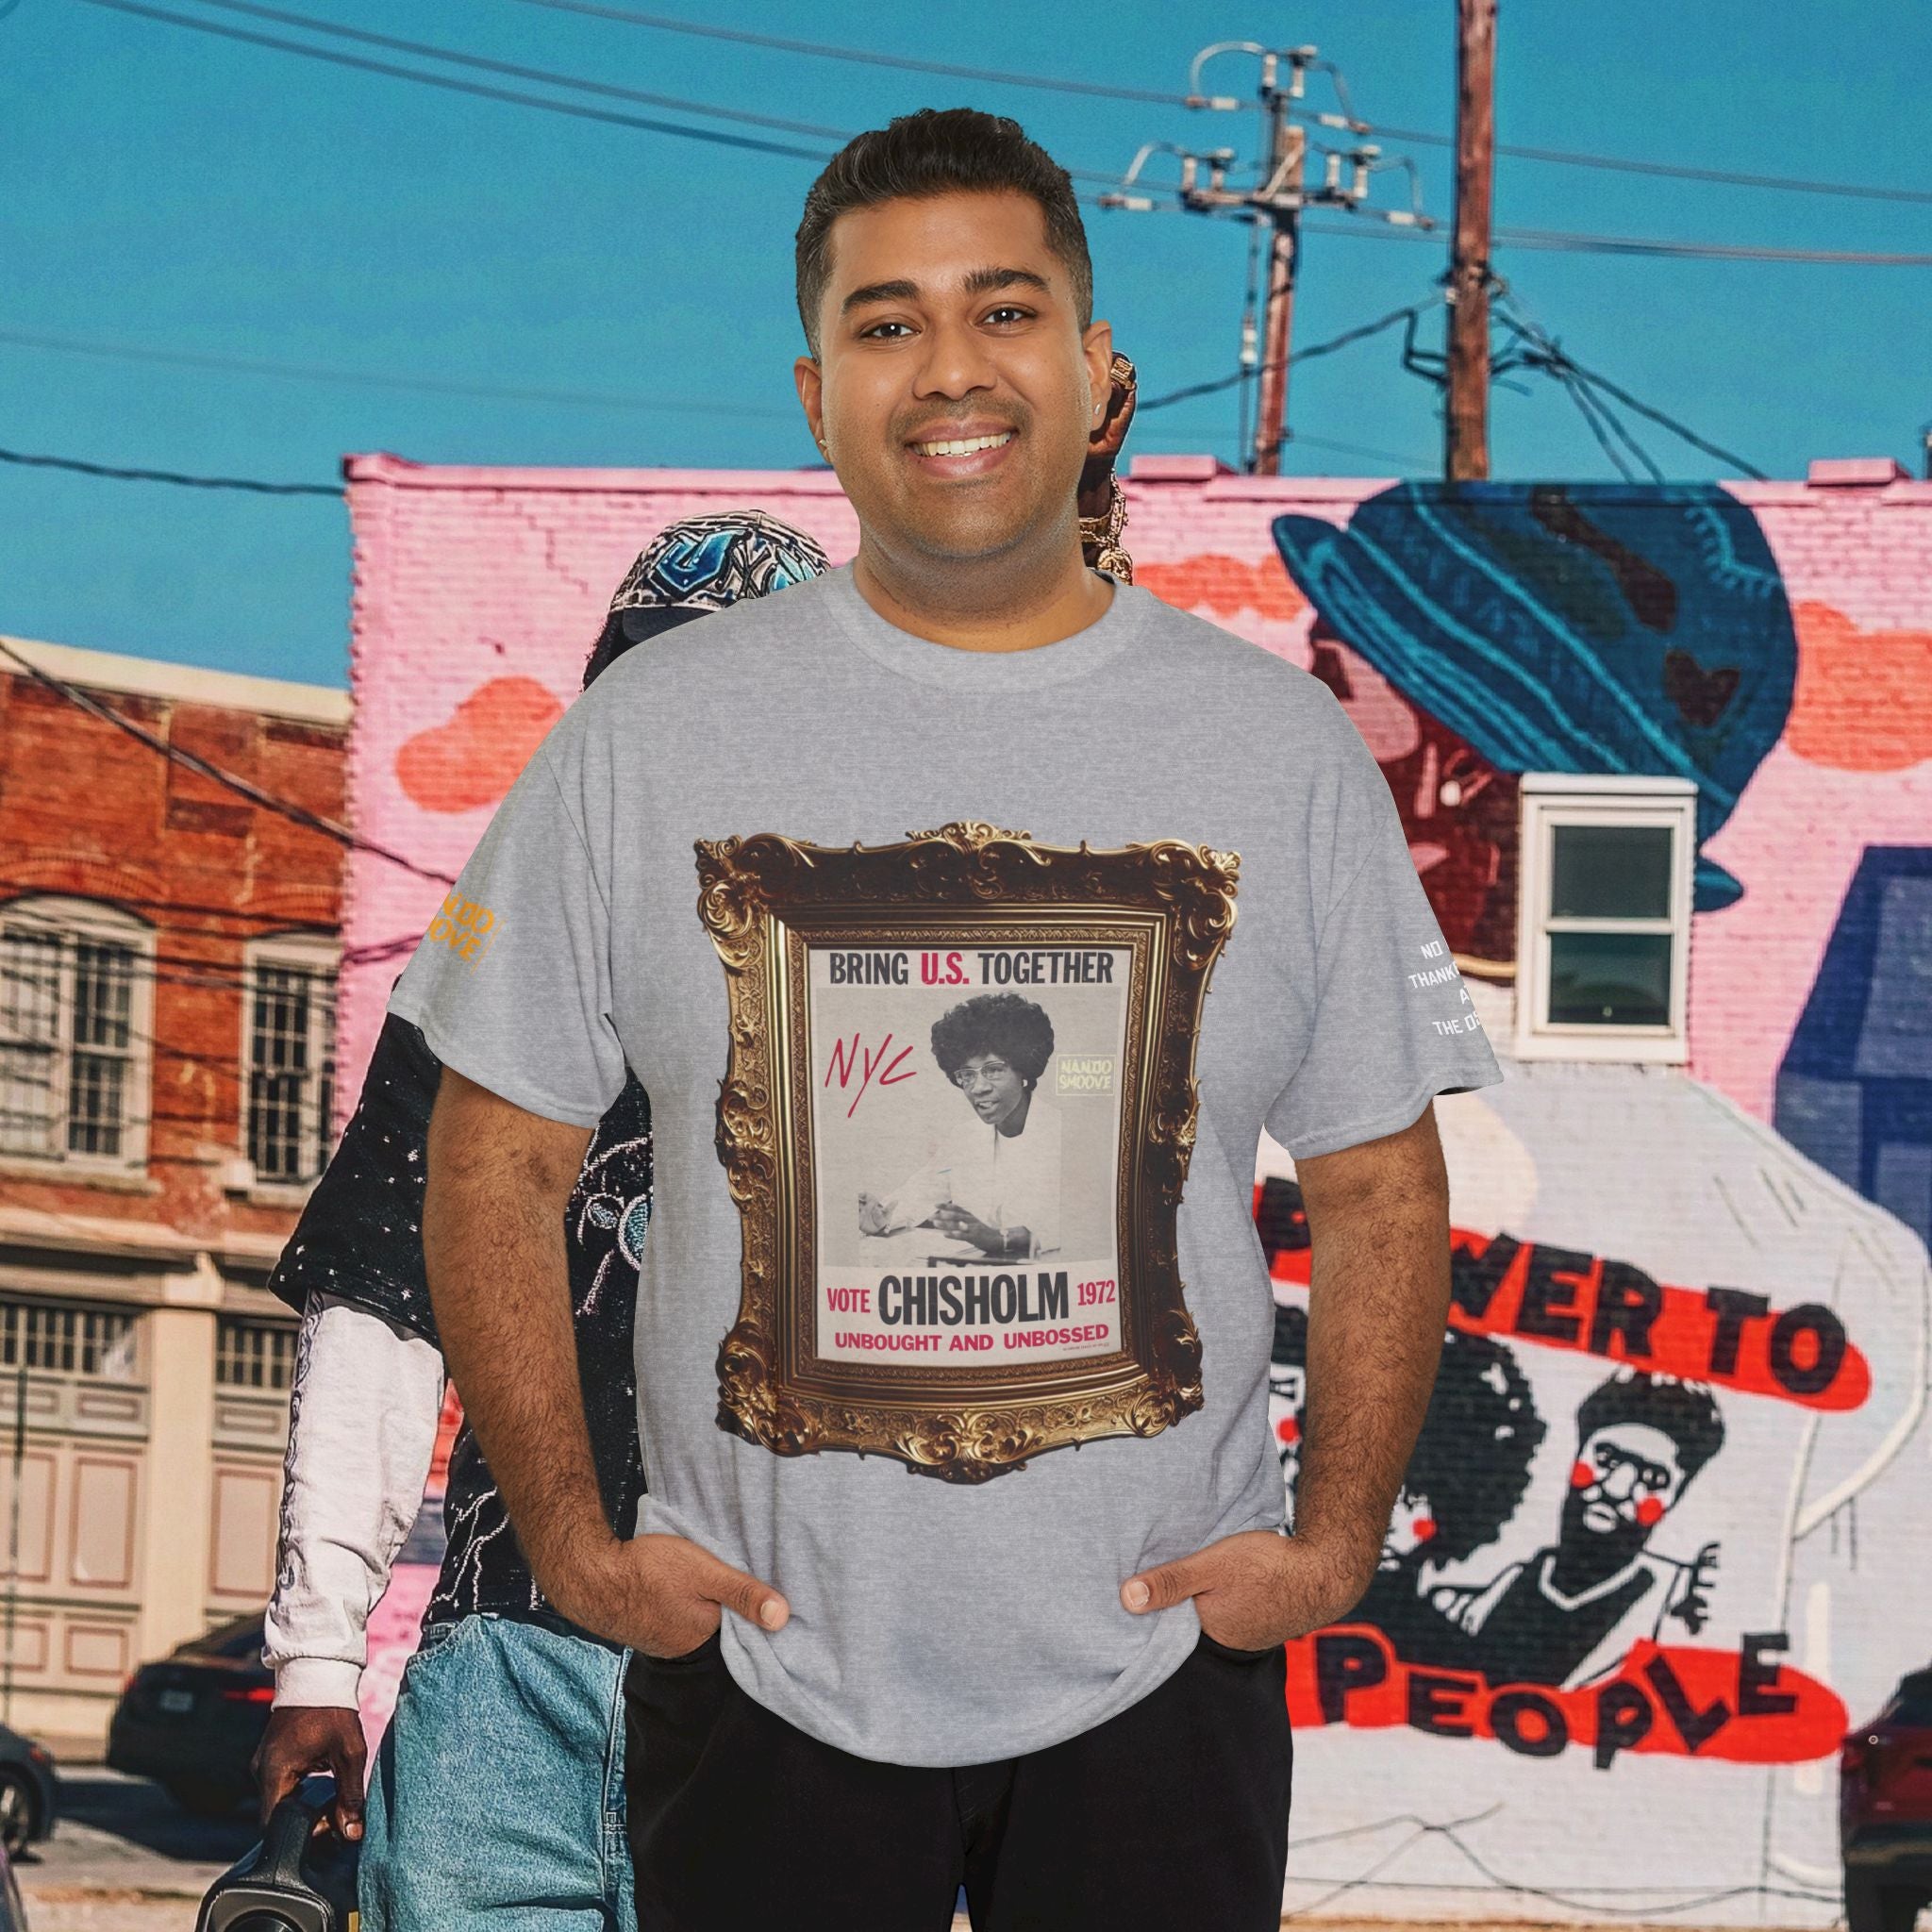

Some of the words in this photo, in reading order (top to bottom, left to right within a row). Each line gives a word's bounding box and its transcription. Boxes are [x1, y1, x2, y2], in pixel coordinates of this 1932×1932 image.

[829, 952, 908, 985] BRING
[921, 952, 970, 985] U.S.
[977, 951, 1114, 984] TOGETHER
[1432, 1020, 1464, 1036] THE
[824, 1032, 917, 1118] NYC
[826, 1287, 871, 1313] VOTE
[877, 1271, 1069, 1326] CHISHOLM
[1076, 1279, 1115, 1307] 1972
[1258, 1175, 1663, 1358] PWER
[1706, 1286, 1848, 1394] TO
[834, 1332, 942, 1352] UNBOUGHT
[948, 1334, 993, 1352] AND
[1003, 1324, 1109, 1351] UNBOSSED
[1315, 1632, 1798, 1770] PEOPLE
